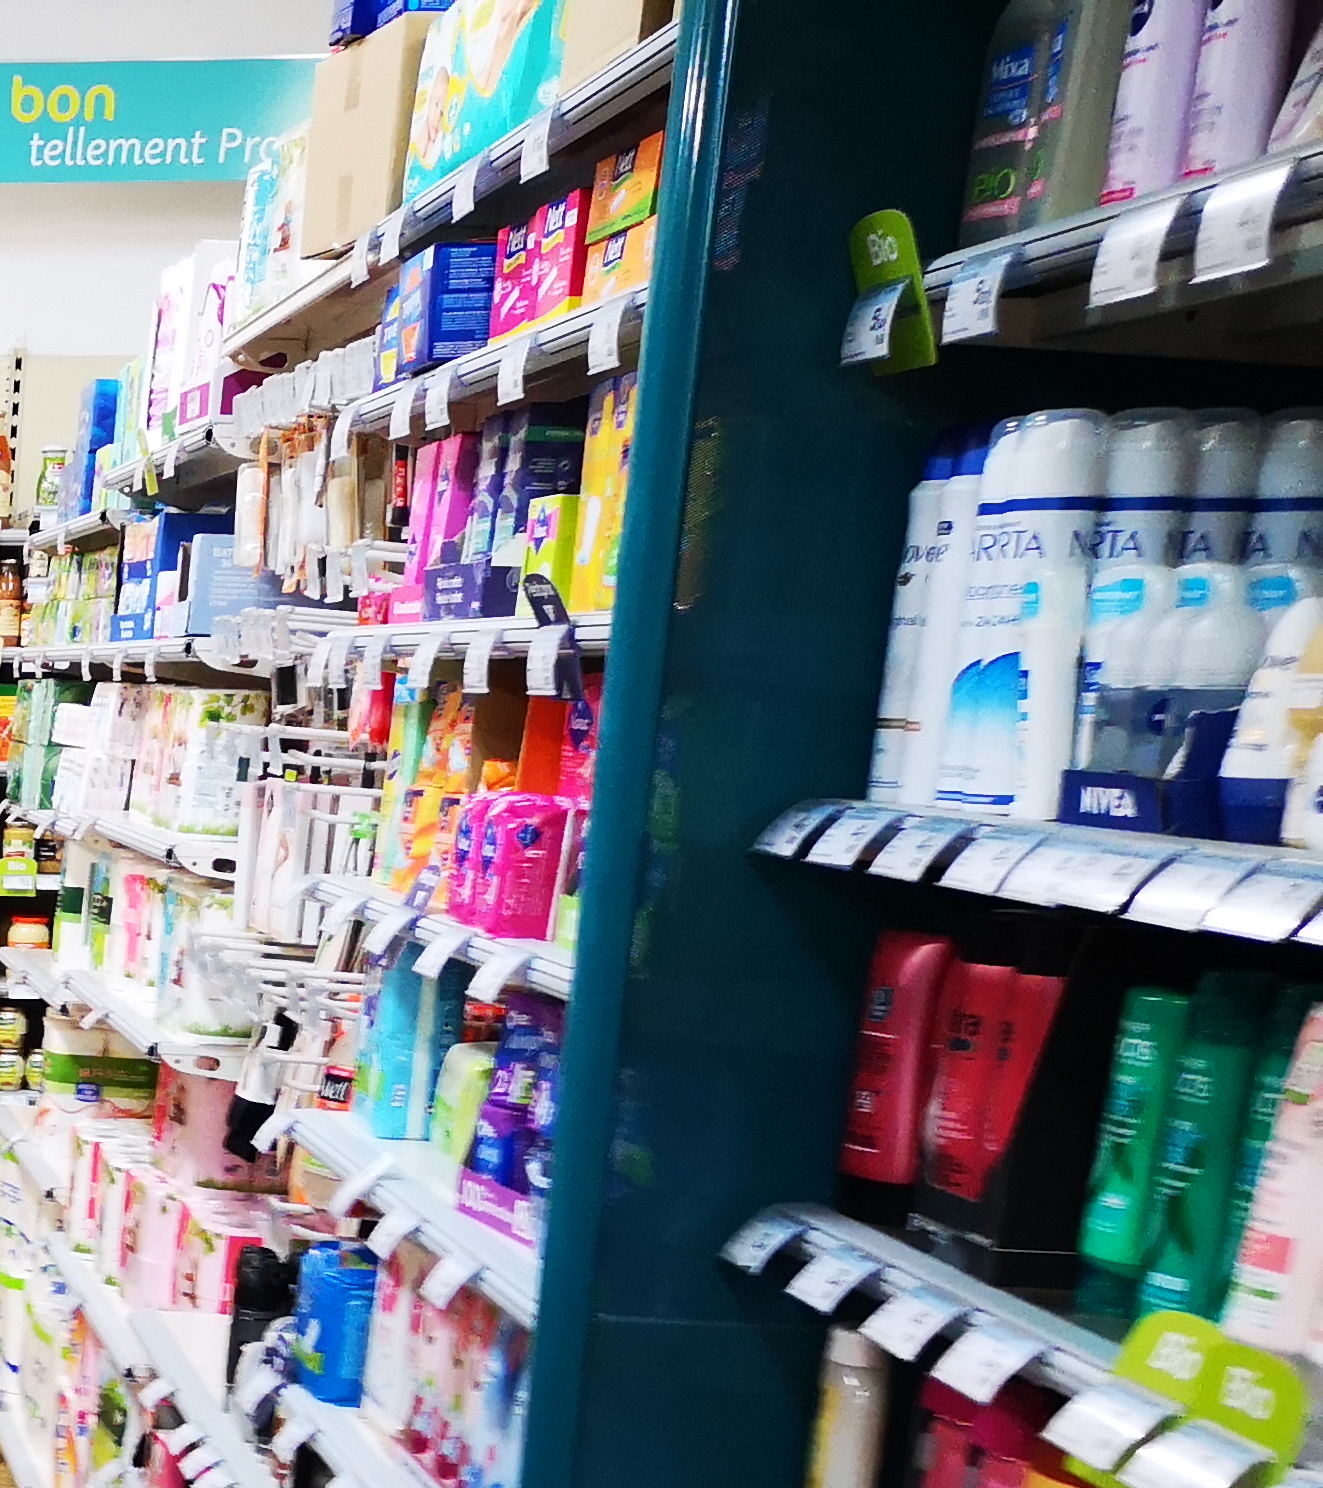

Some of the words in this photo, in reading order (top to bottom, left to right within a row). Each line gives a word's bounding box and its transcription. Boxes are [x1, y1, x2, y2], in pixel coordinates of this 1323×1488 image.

[11, 76, 116, 124] bon
[29, 128, 206, 167] tellement
[219, 128, 279, 165] Pro
[545, 202, 566, 234] Nett
[866, 228, 899, 267] Bio
[1079, 786, 1139, 818] NIVEA
[7, 860, 27, 872] Bio
